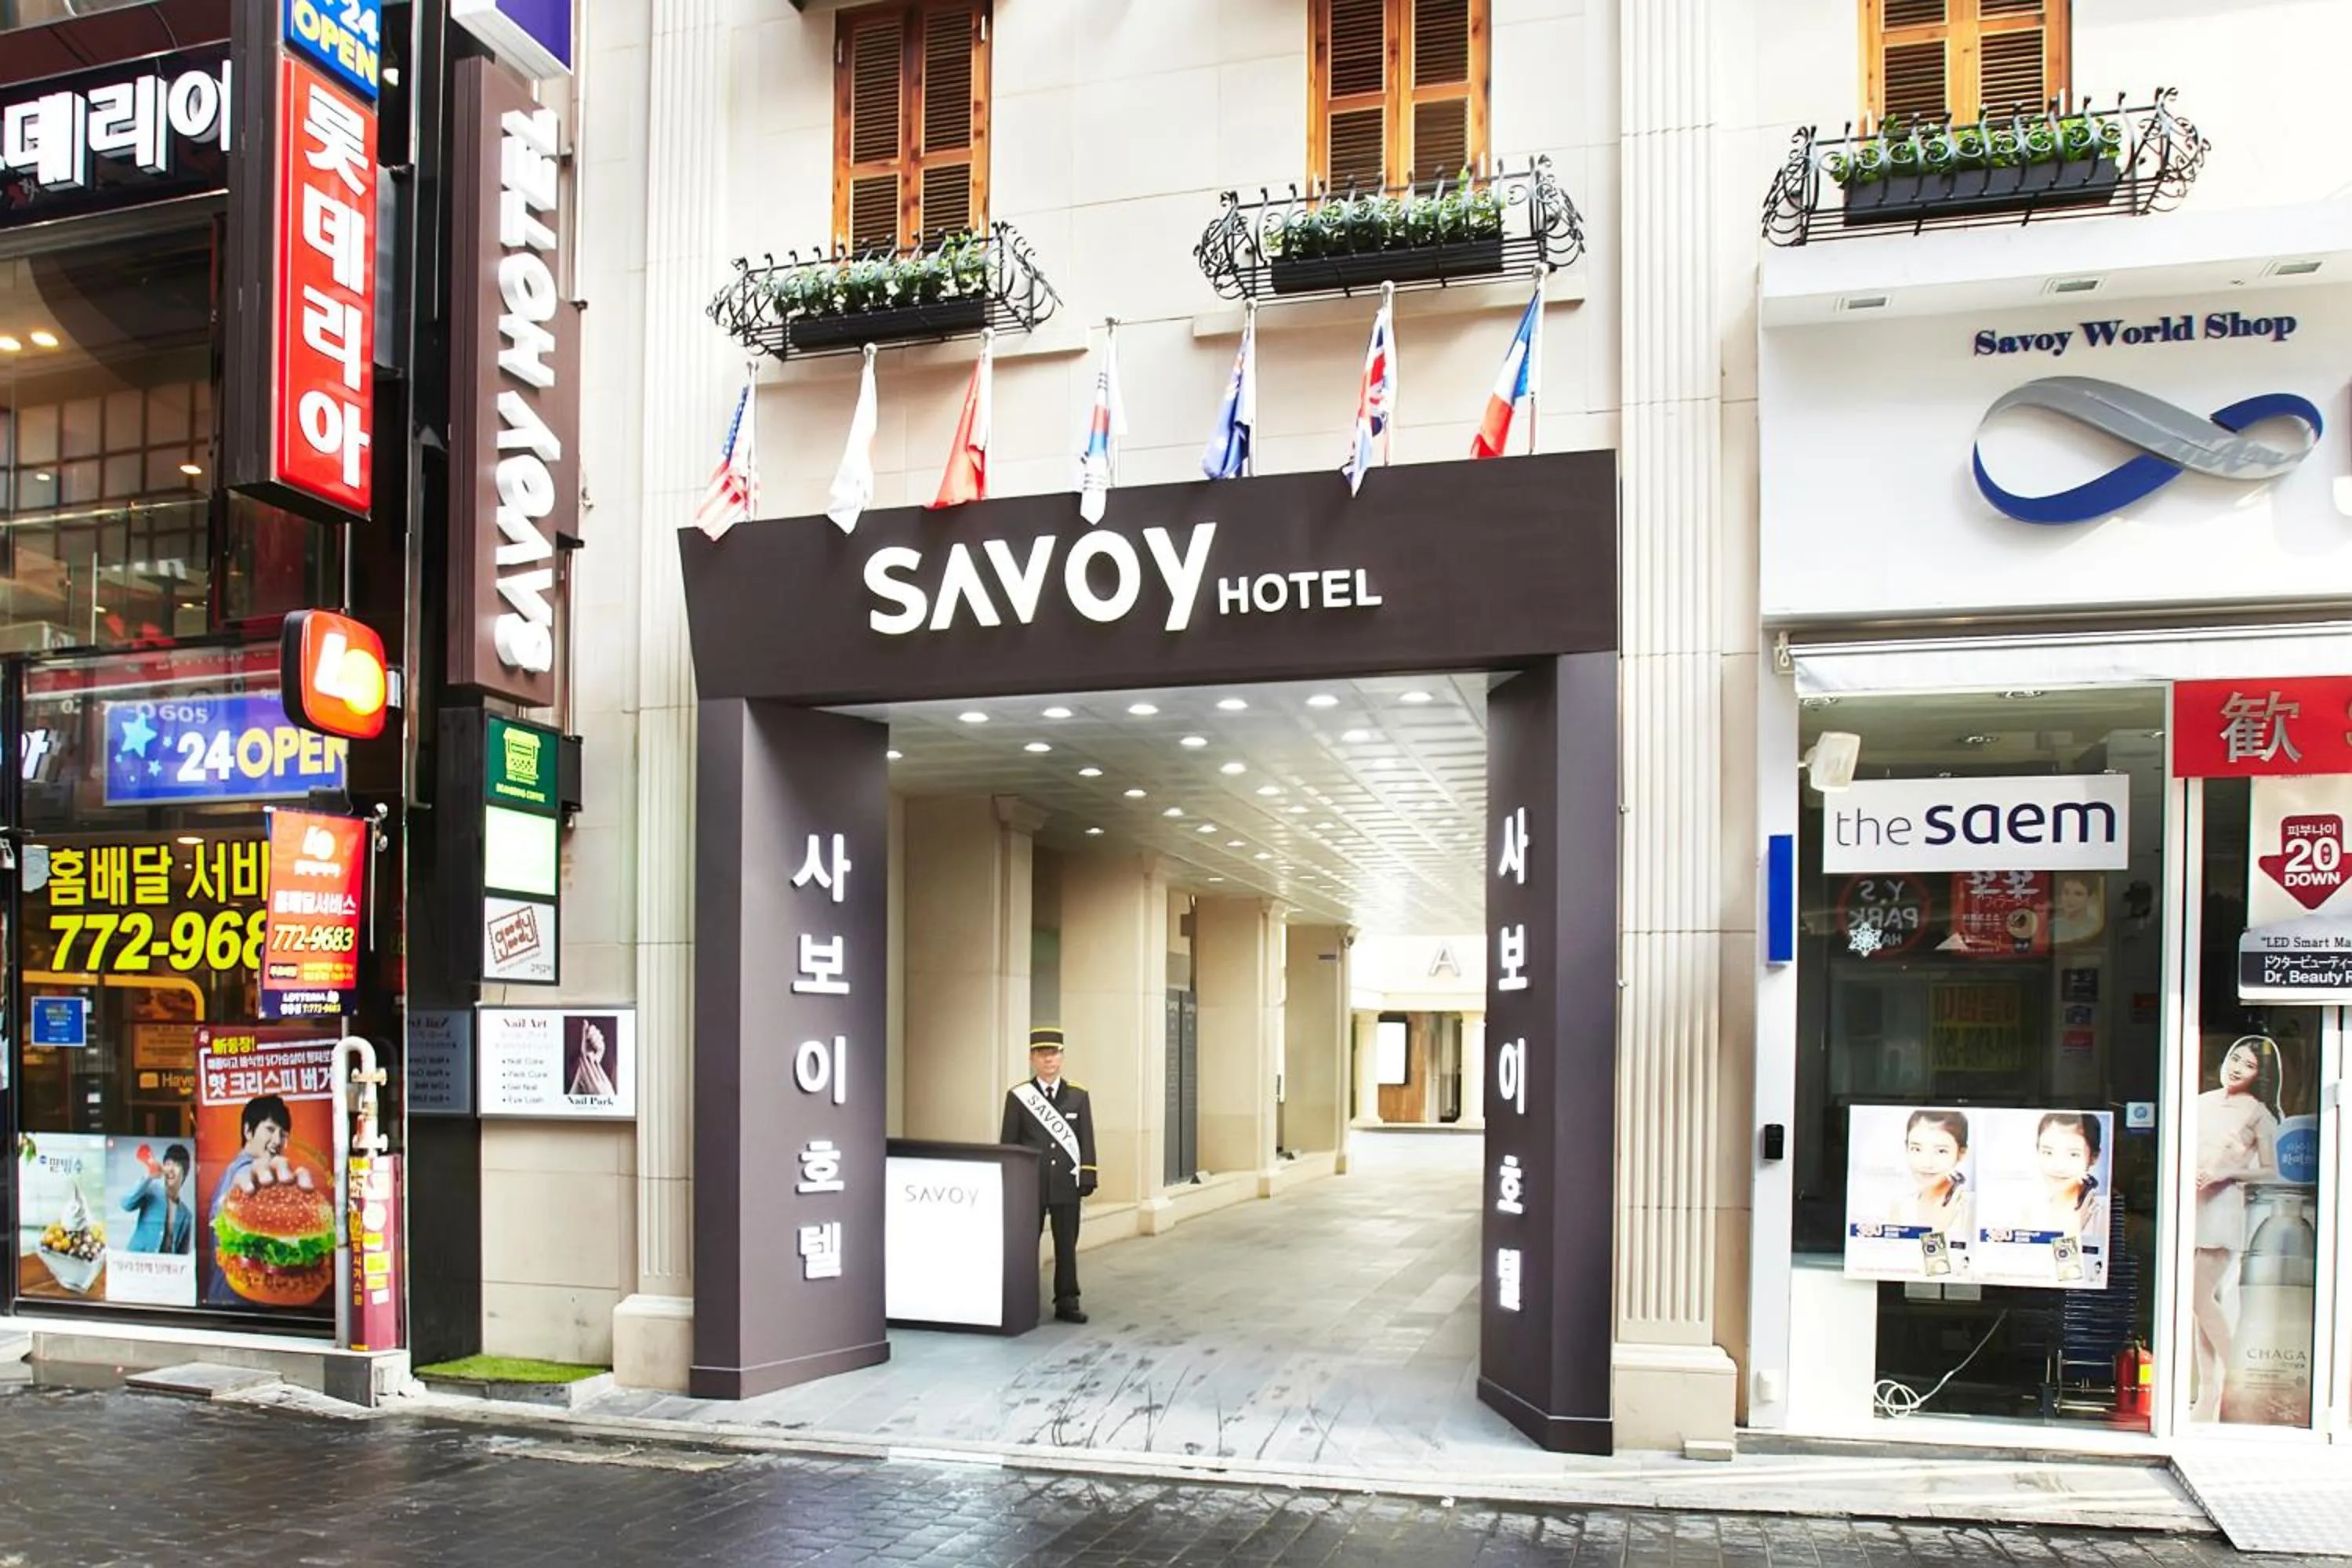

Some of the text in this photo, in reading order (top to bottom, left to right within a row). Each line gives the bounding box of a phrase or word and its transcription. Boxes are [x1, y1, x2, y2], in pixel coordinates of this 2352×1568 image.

[294, 0, 377, 88] OPEN
[0, 60, 232, 187] 데리아
[299, 82, 370, 489] 롯데리아
[1973, 311, 2297, 357] Savoy World Shop
[494, 107, 561, 673] SAVOY HOTEL
[863, 521, 1382, 635] SAVOY HOTEL
[177, 727, 347, 782] 24 OPEN
[1835, 800, 2116, 847] the saem
[2287, 823, 2336, 836] 피부나이
[49, 848, 174, 907] 홈배달
[2284, 837, 2341, 873] 20
[2284, 871, 2341, 887] DOWN
[271, 924, 354, 953] 772-9683
[2293, 937, 2329, 948] Smart
[2264, 970, 2287, 985] Dr.
[2288, 970, 2343, 986] Beauty
[229, 1068, 298, 1096] 크리스피
[1027, 1094, 1073, 1142] SAVOY
[905, 1184, 979, 1207] SAVOY
[2245, 1348, 2307, 1362] CHAGA
